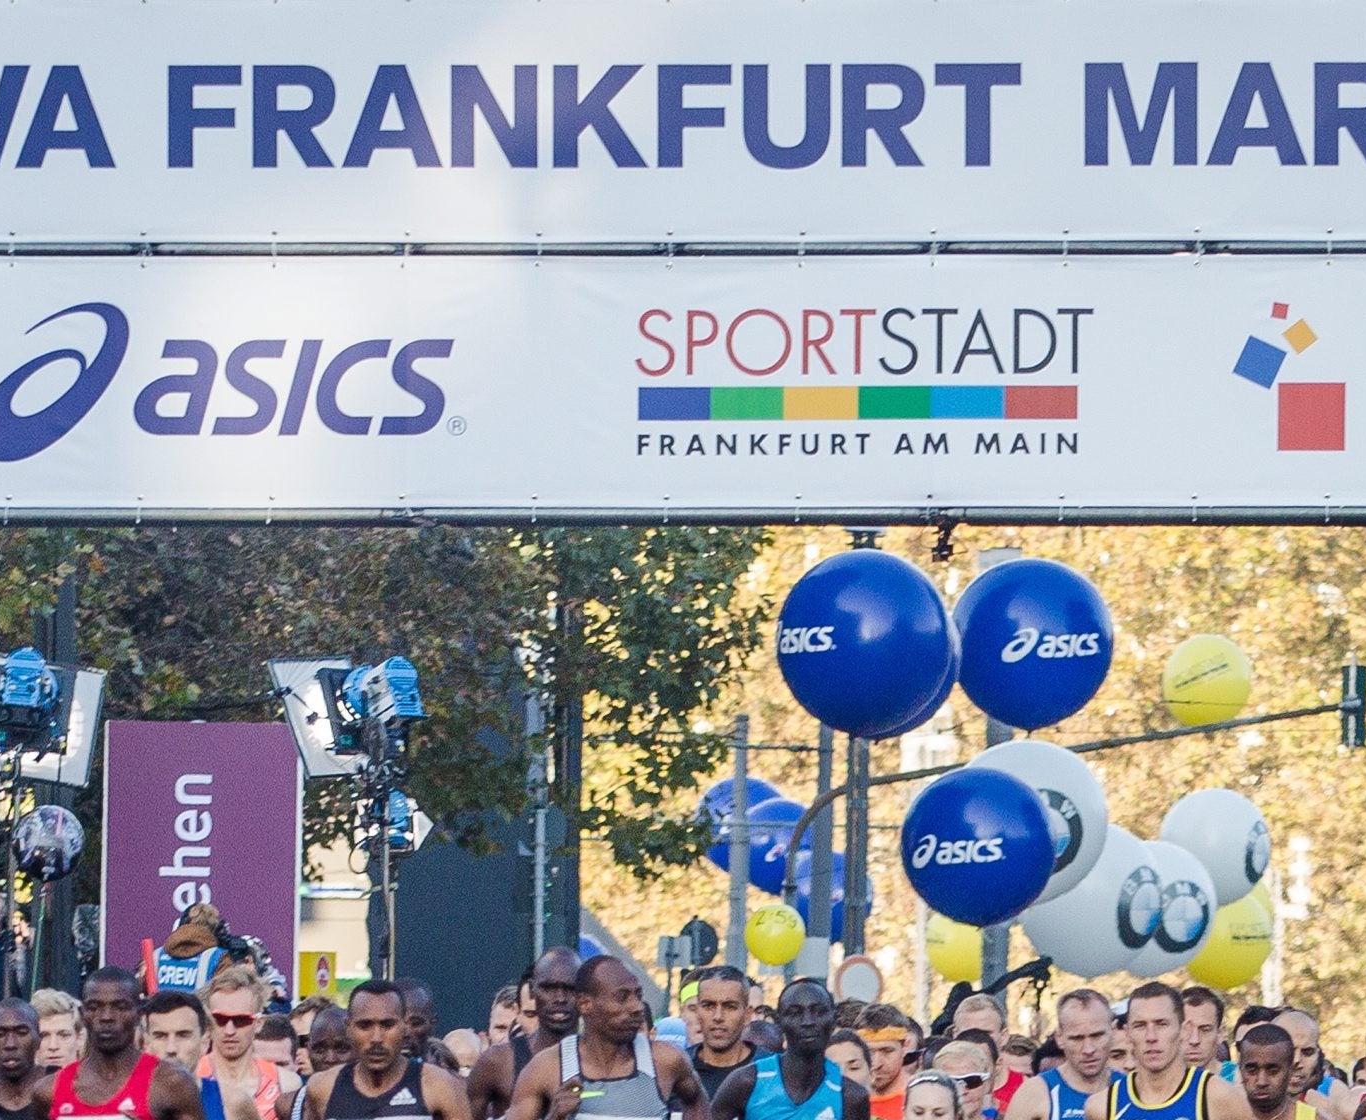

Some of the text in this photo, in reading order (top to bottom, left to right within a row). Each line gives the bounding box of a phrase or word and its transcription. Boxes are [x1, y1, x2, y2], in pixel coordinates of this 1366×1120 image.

[167, 61, 1022, 169] FRANKFURT
[634, 307, 1095, 377] SPORTSTADT
[636, 431, 1080, 456] FRANKFURT AM MAIN
[158, 773, 214, 932] ehen
[157, 964, 198, 987] CREW
